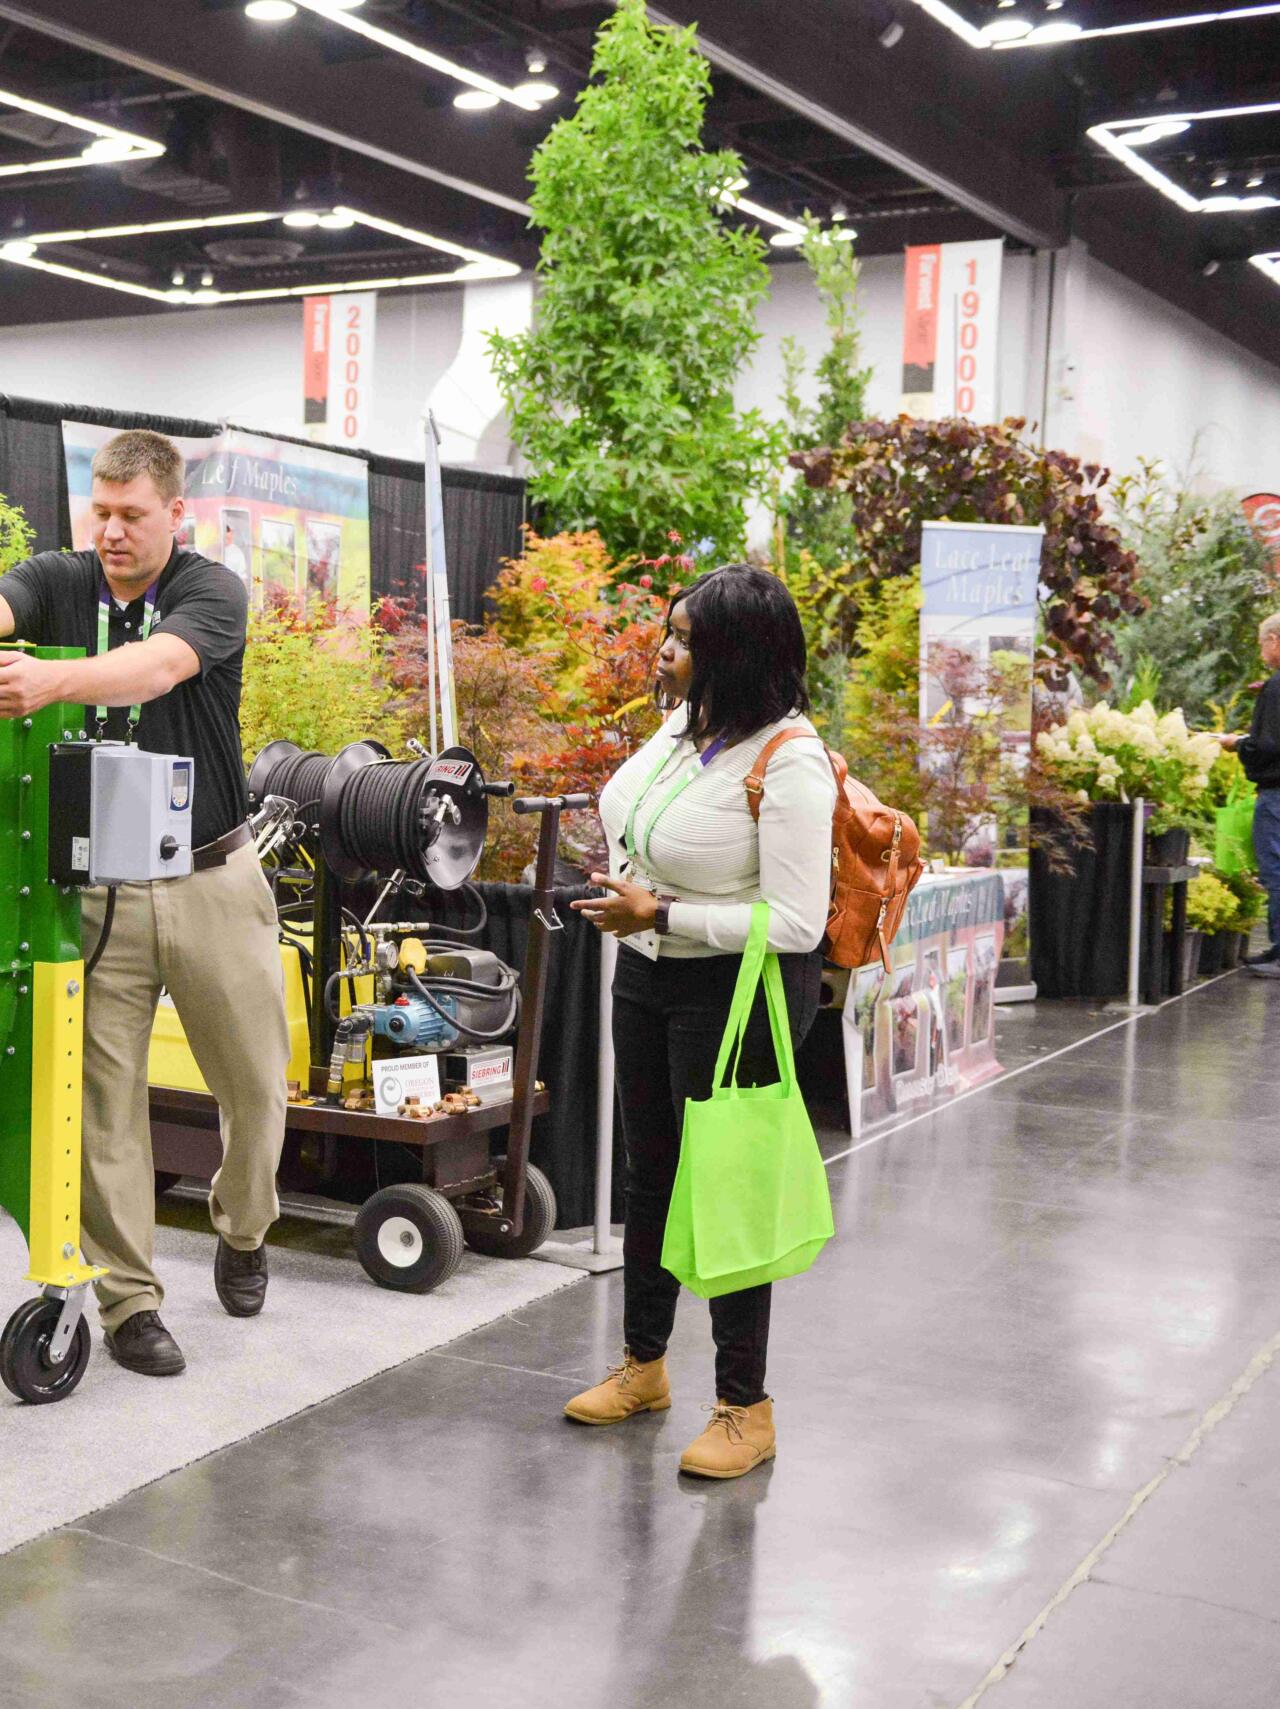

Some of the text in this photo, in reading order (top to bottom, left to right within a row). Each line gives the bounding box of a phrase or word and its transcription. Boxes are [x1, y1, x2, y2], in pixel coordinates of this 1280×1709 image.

[956, 258, 980, 413] 19000
[343, 305, 361, 438] 20000
[243, 459, 297, 500] Maples
[935, 540, 980, 571] Lace
[945, 575, 1024, 614] Maples
[380, 1061, 430, 1073] PROUD MEMBER OF
[471, 1065, 502, 1080] SIEBRING
